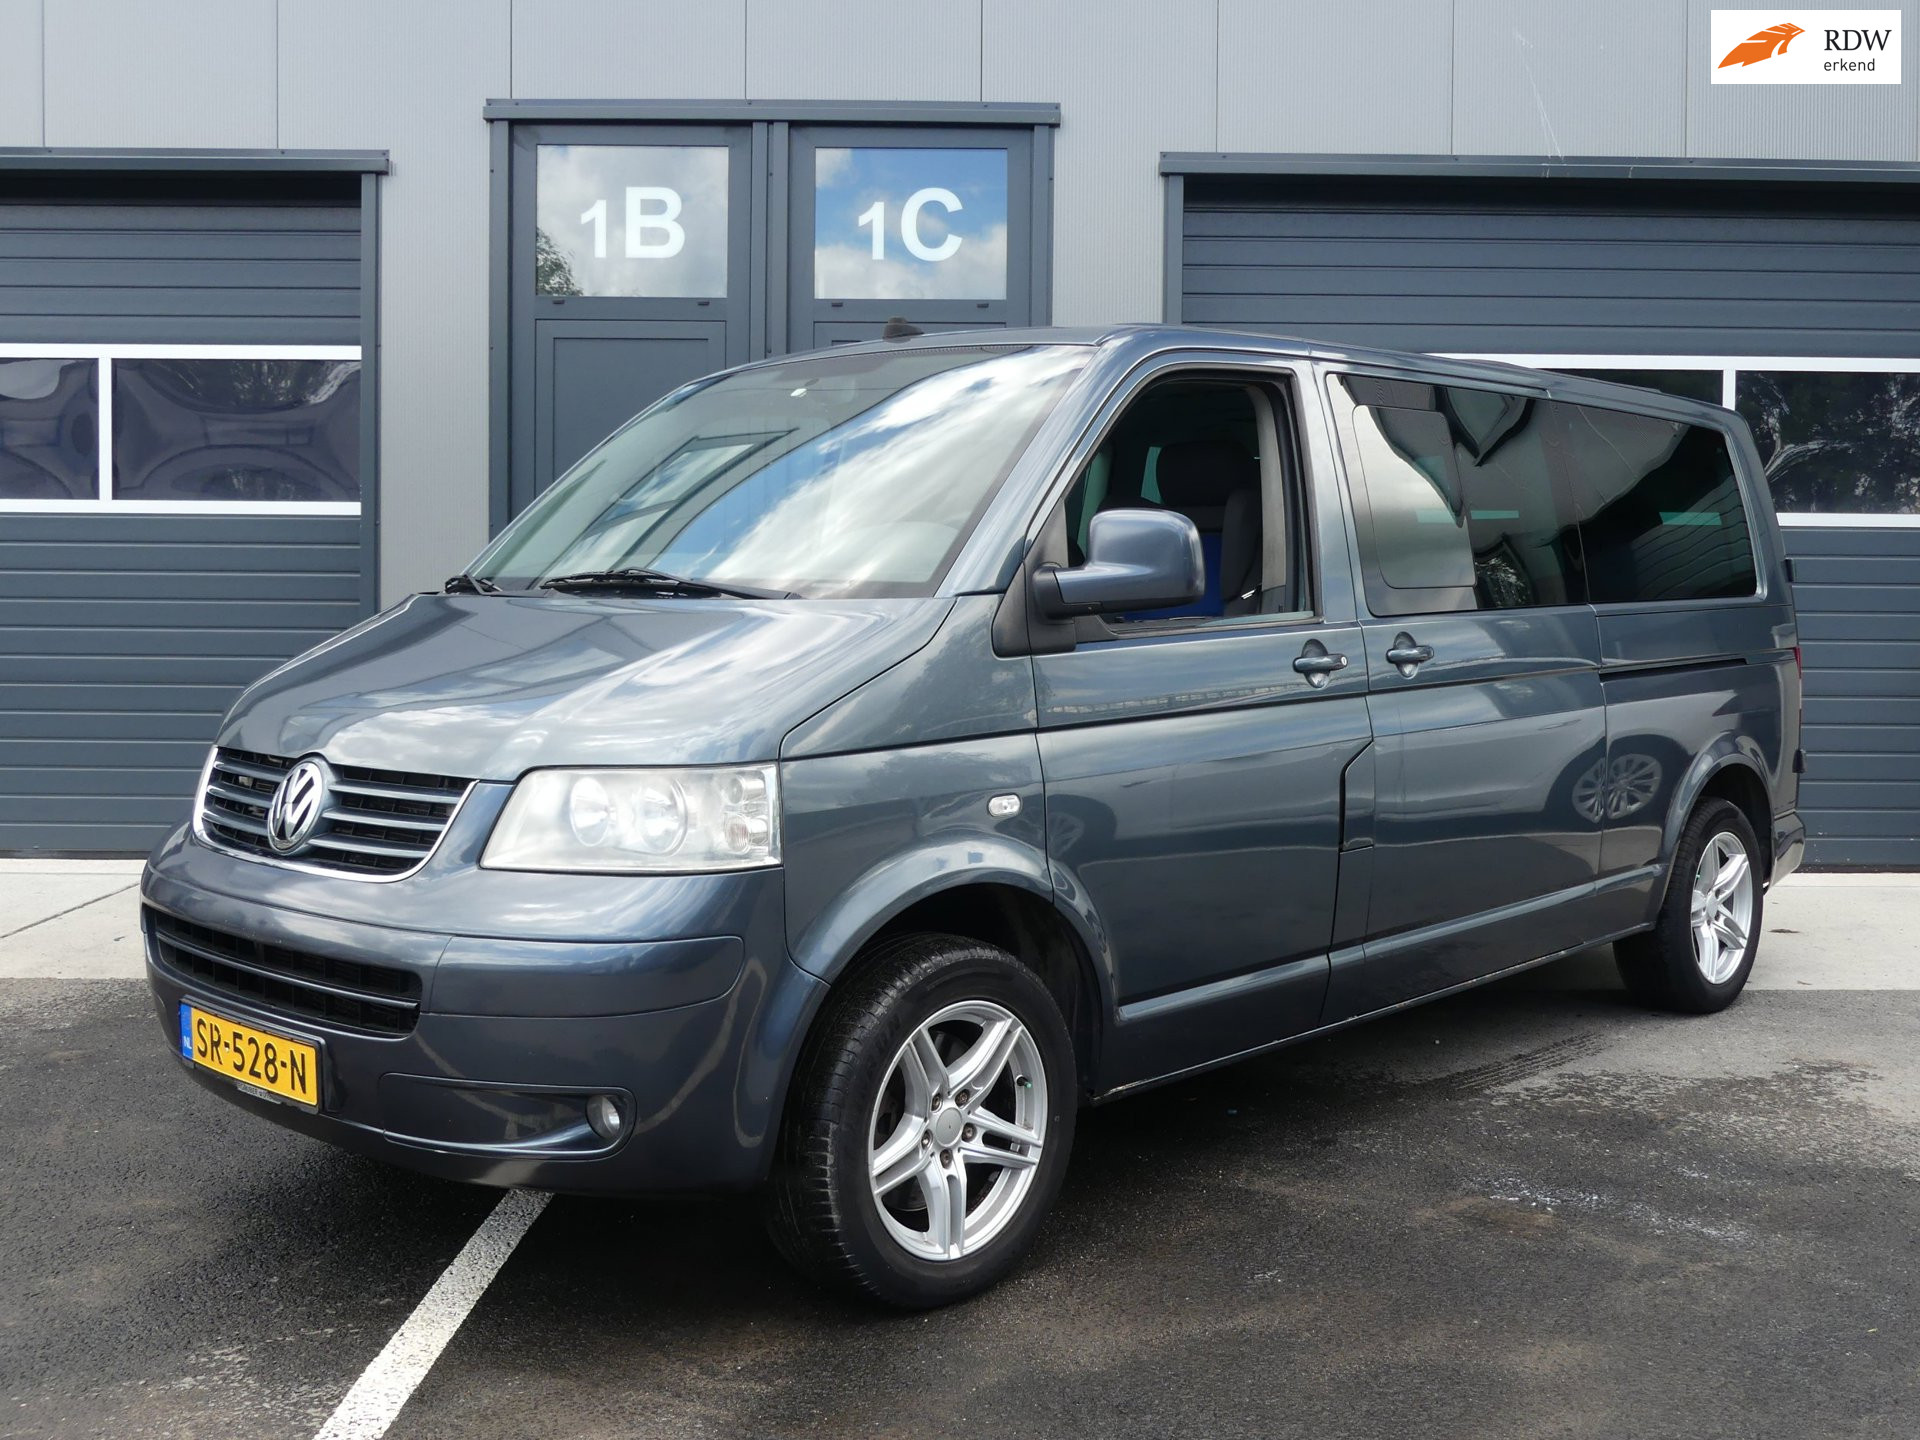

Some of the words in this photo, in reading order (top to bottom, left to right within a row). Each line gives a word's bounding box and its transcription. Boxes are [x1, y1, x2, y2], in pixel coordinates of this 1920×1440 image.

[580, 186, 686, 259] 1B
[857, 187, 964, 262] 1C
[270, 761, 322, 850] VW
[183, 1035, 192, 1050] NL
[196, 1017, 307, 1095] SR-528-N
